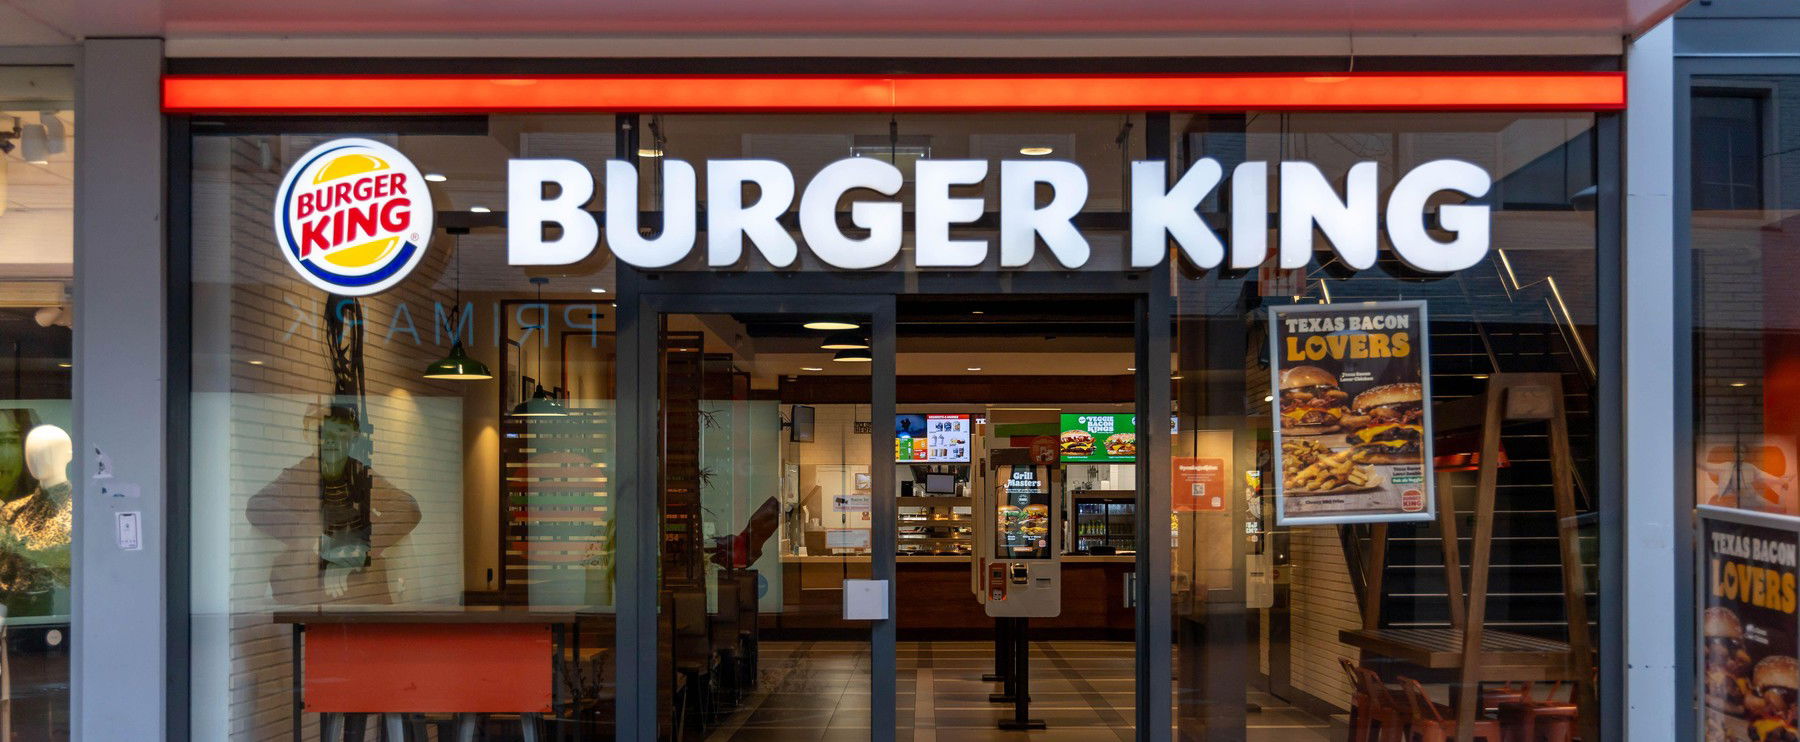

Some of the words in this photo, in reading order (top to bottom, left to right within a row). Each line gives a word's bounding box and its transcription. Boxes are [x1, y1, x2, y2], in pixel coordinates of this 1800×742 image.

[297, 172, 408, 220] BURGER
[301, 198, 412, 258] KING
[508, 158, 1090, 269] BURGER
[1131, 157, 1492, 273] KING
[1285, 317, 1345, 333] TEXAS
[1348, 315, 1409, 332] BACON
[1286, 332, 1411, 362] LOVERS
[1003, 479, 1042, 488] Masters
[1013, 471, 1033, 480] Grill
[1712, 532, 1750, 559] TEXAS
[1752, 538, 1796, 567] BACON
[1711, 559, 1796, 614] LOVERS
